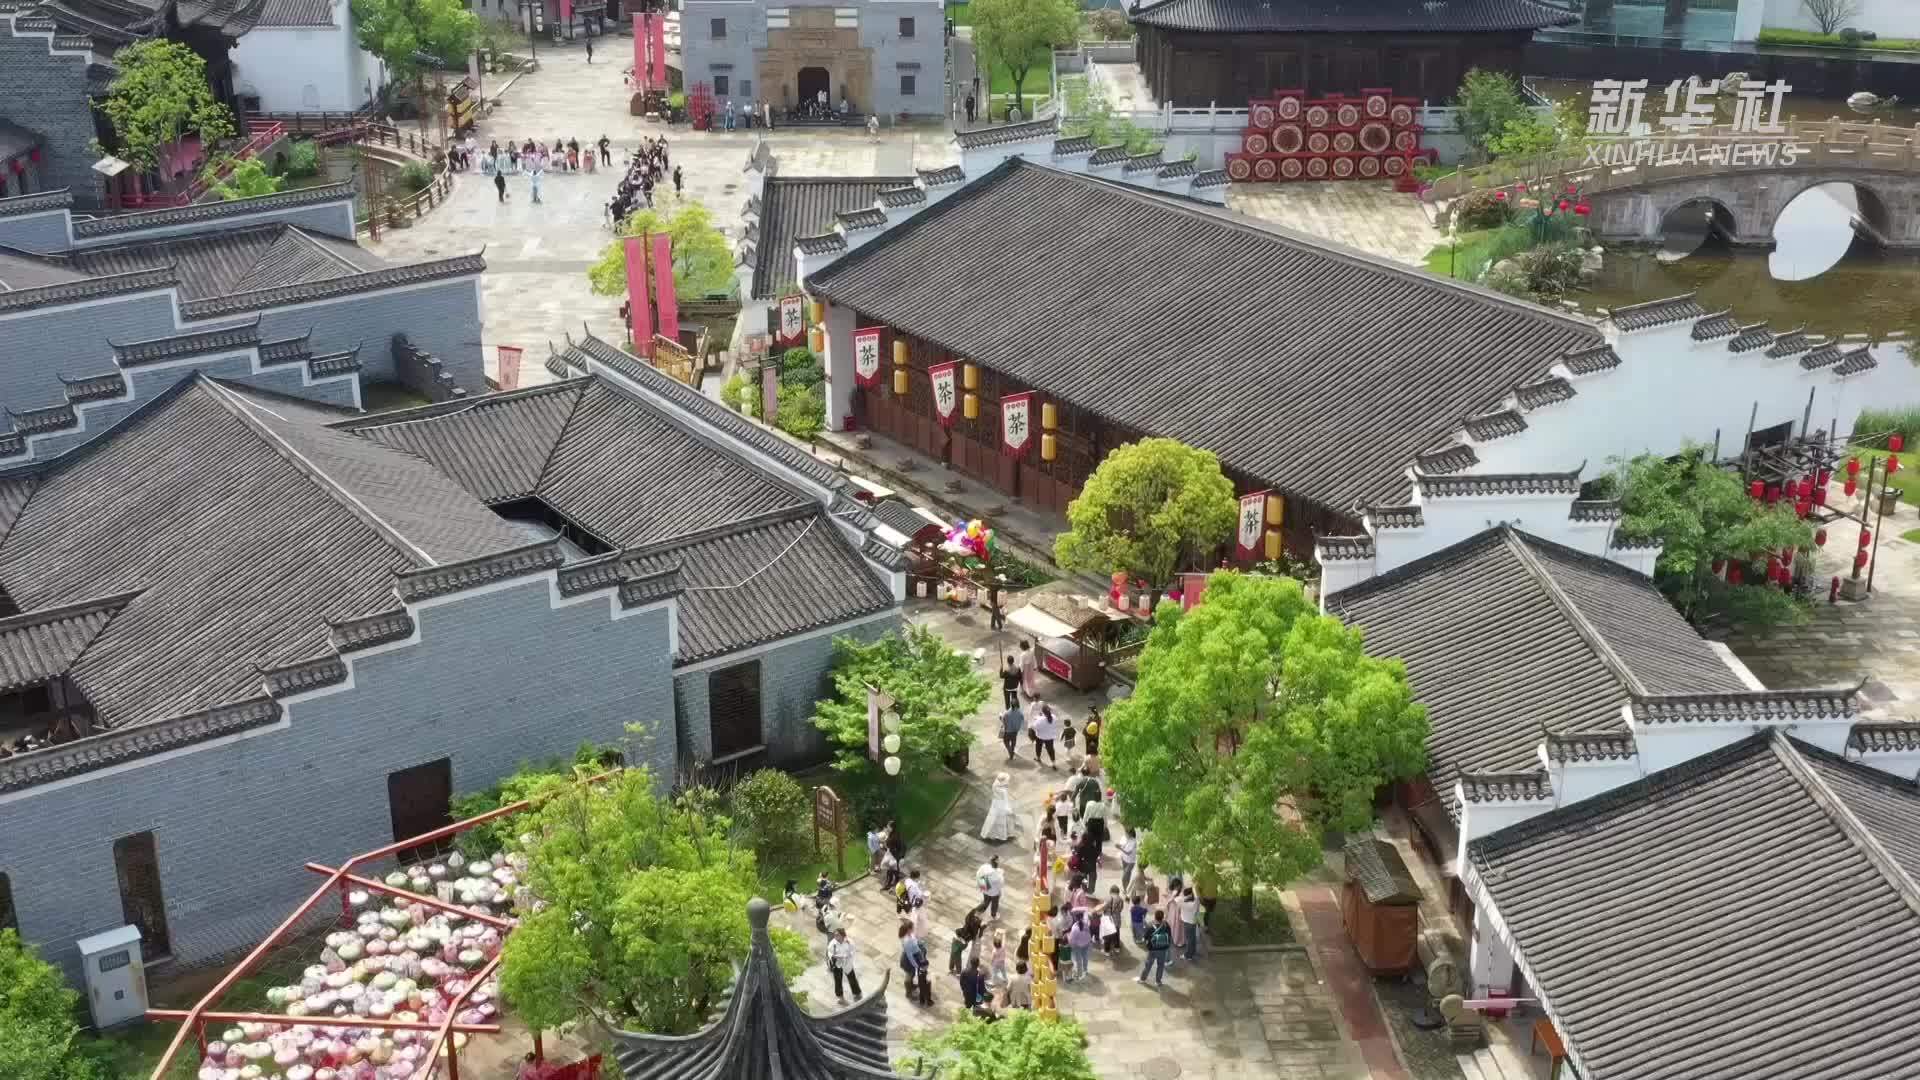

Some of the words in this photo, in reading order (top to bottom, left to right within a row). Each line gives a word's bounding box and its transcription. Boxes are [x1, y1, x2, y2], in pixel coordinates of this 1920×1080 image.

[859, 345, 876, 366] 茶
[937, 381, 953, 404] 茶
[1008, 412, 1026, 435] 茶
